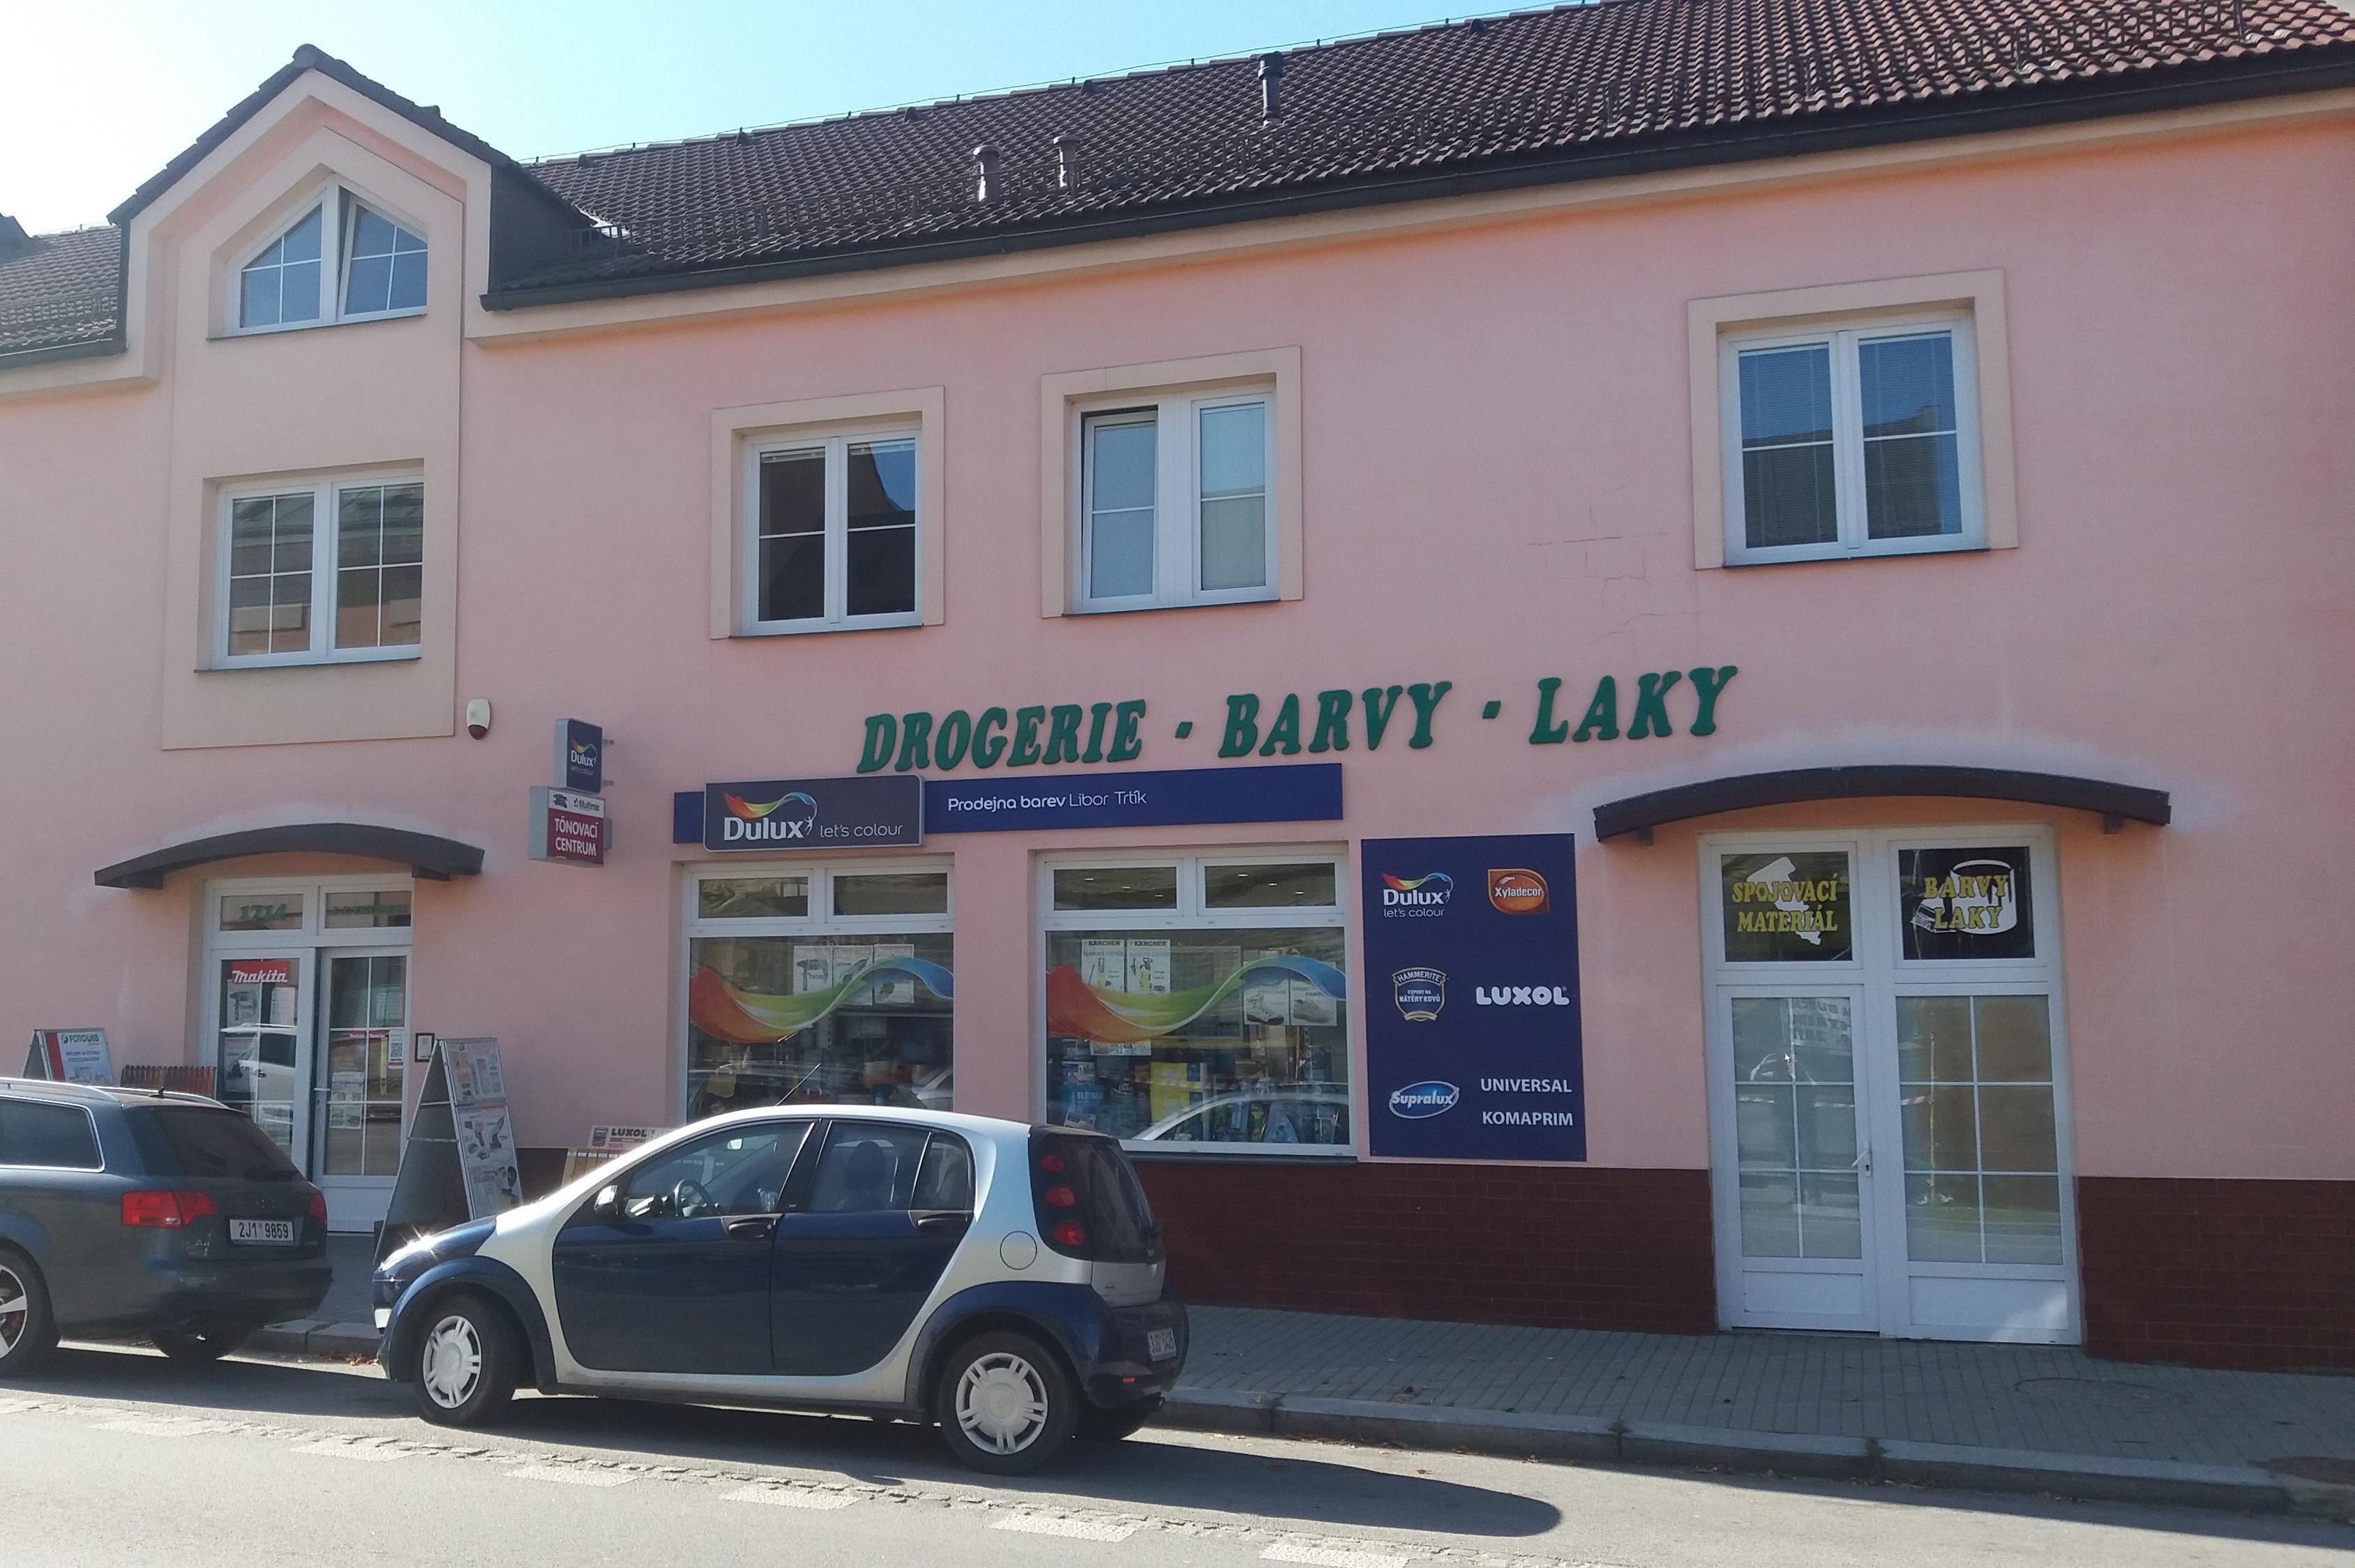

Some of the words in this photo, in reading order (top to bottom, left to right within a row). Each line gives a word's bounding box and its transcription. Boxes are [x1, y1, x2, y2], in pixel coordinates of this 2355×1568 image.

[857, 699, 1146, 773] DROGERIE
[1218, 681, 1452, 759] BARVY
[1530, 665, 1738, 746] LAKY
[571, 749, 594, 768] Dulux
[947, 797, 1016, 813] Prodejna
[1020, 794, 1066, 809] barev
[1069, 792, 1109, 807] Libor
[1114, 790, 1148, 806] Trtík
[555, 815, 598, 838] TÓNOVACÍ
[723, 816, 804, 841] Dulux
[820, 823, 850, 838] let's
[854, 823, 903, 838] colour
[555, 836, 597, 857] CENTRUM
[1493, 886, 1542, 898] Xyladecor
[1731, 873, 1838, 903] SPOJOVACÍ
[1923, 874, 2009, 899] BARVY
[1383, 889, 1445, 905] Dulux
[1384, 908, 1406, 918] let's
[1408, 907, 1445, 917] colour
[1737, 905, 1837, 933] MATERIÁL
[1934, 906, 2003, 930] LAKY
[1397, 970, 1442, 983] HAMMERITE
[1424, 993, 1440, 1002] KOVŮ
[1475, 986, 1570, 1007] LUXOL
[69, 1034, 100, 1043] FOTOLAB
[1480, 1078, 1572, 1094] UNIVERSAL
[1392, 1089, 1454, 1109] Supralux
[1482, 1111, 1573, 1126] KOMAPRIM
[611, 1128, 647, 1138] LUXOL
[239, 1222, 258, 1238] 2J1
[265, 1223, 289, 1239] 9859
